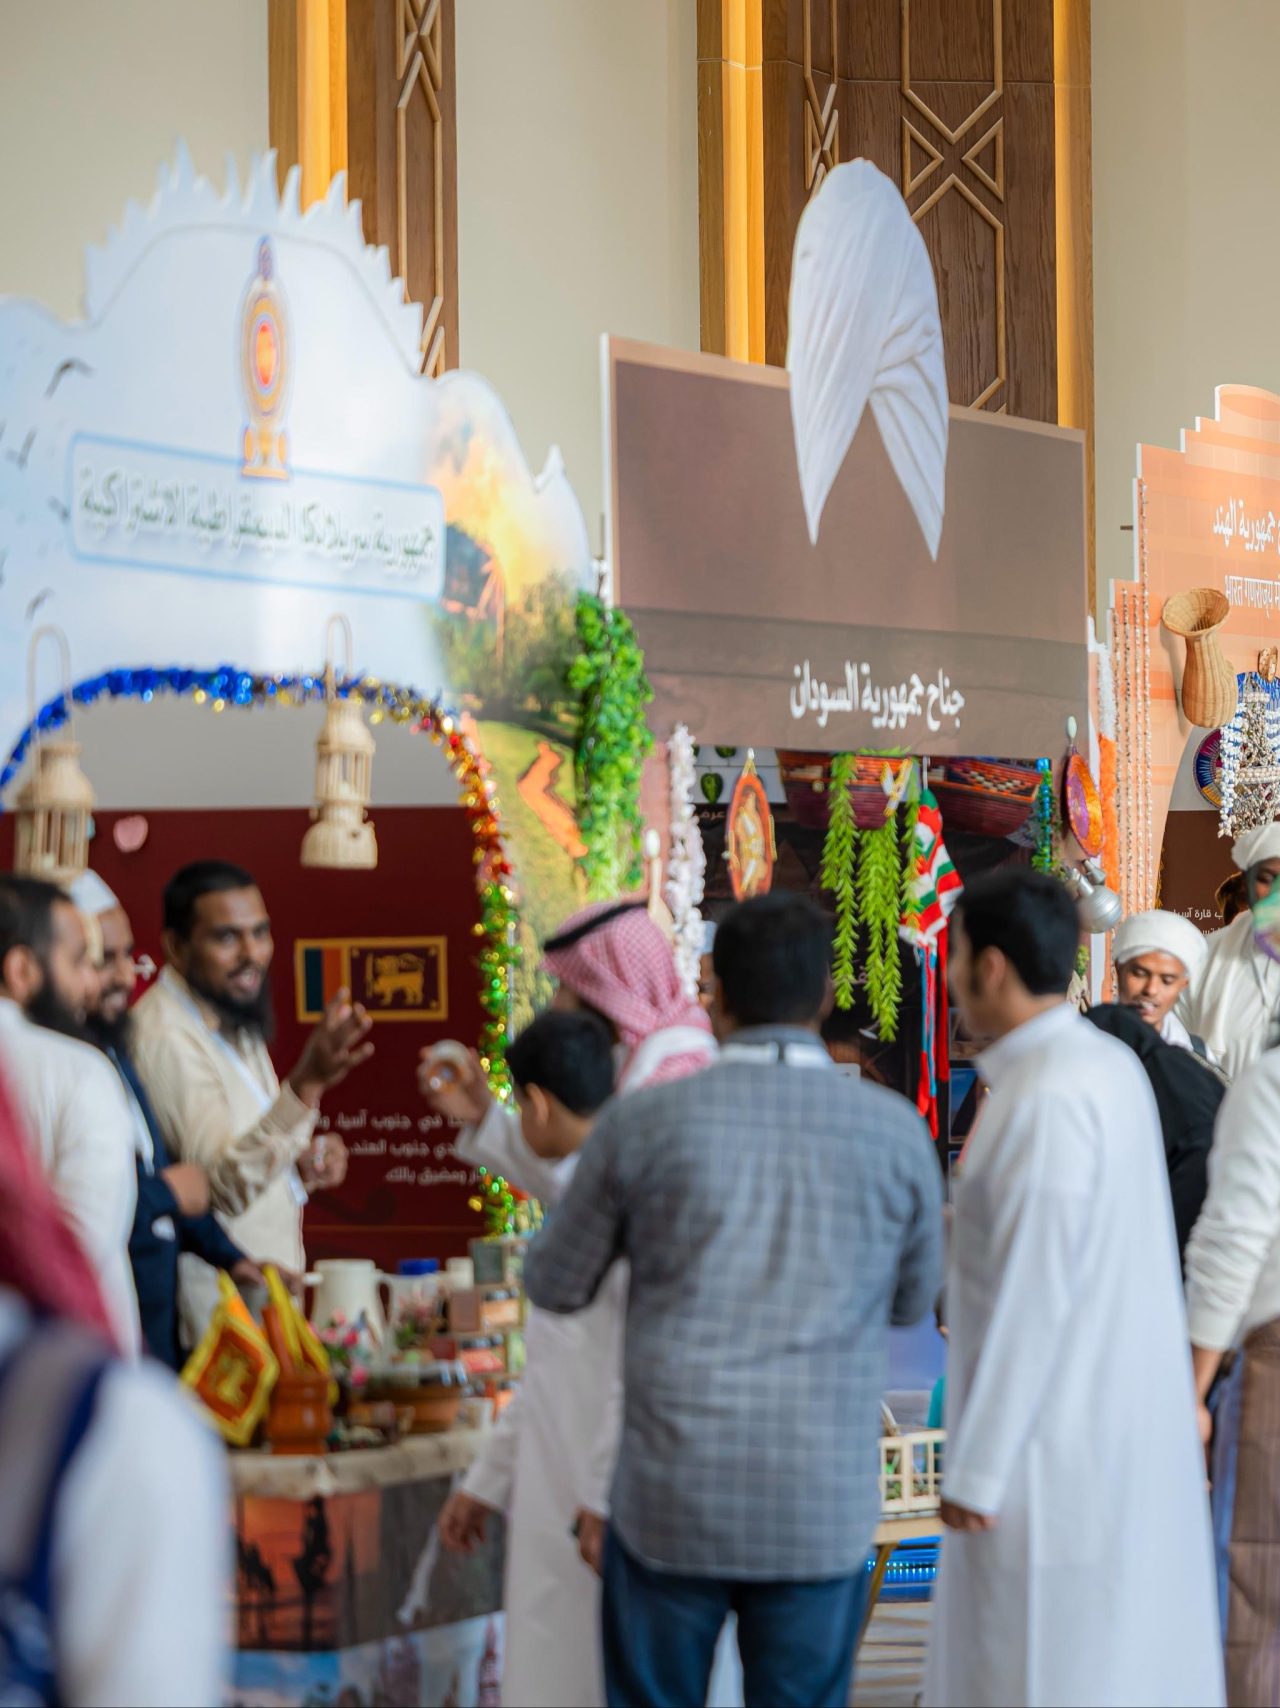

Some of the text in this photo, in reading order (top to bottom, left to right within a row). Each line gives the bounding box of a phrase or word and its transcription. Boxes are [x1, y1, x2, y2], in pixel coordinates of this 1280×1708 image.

[80, 466, 187, 538] الاشتراكية
[1213, 496, 1237, 548] الهند
[1239, 499, 1276, 552] جمهورية
[372, 507, 436, 575] جمهورية
[790, 659, 965, 732] جناح جمهورية السودان
